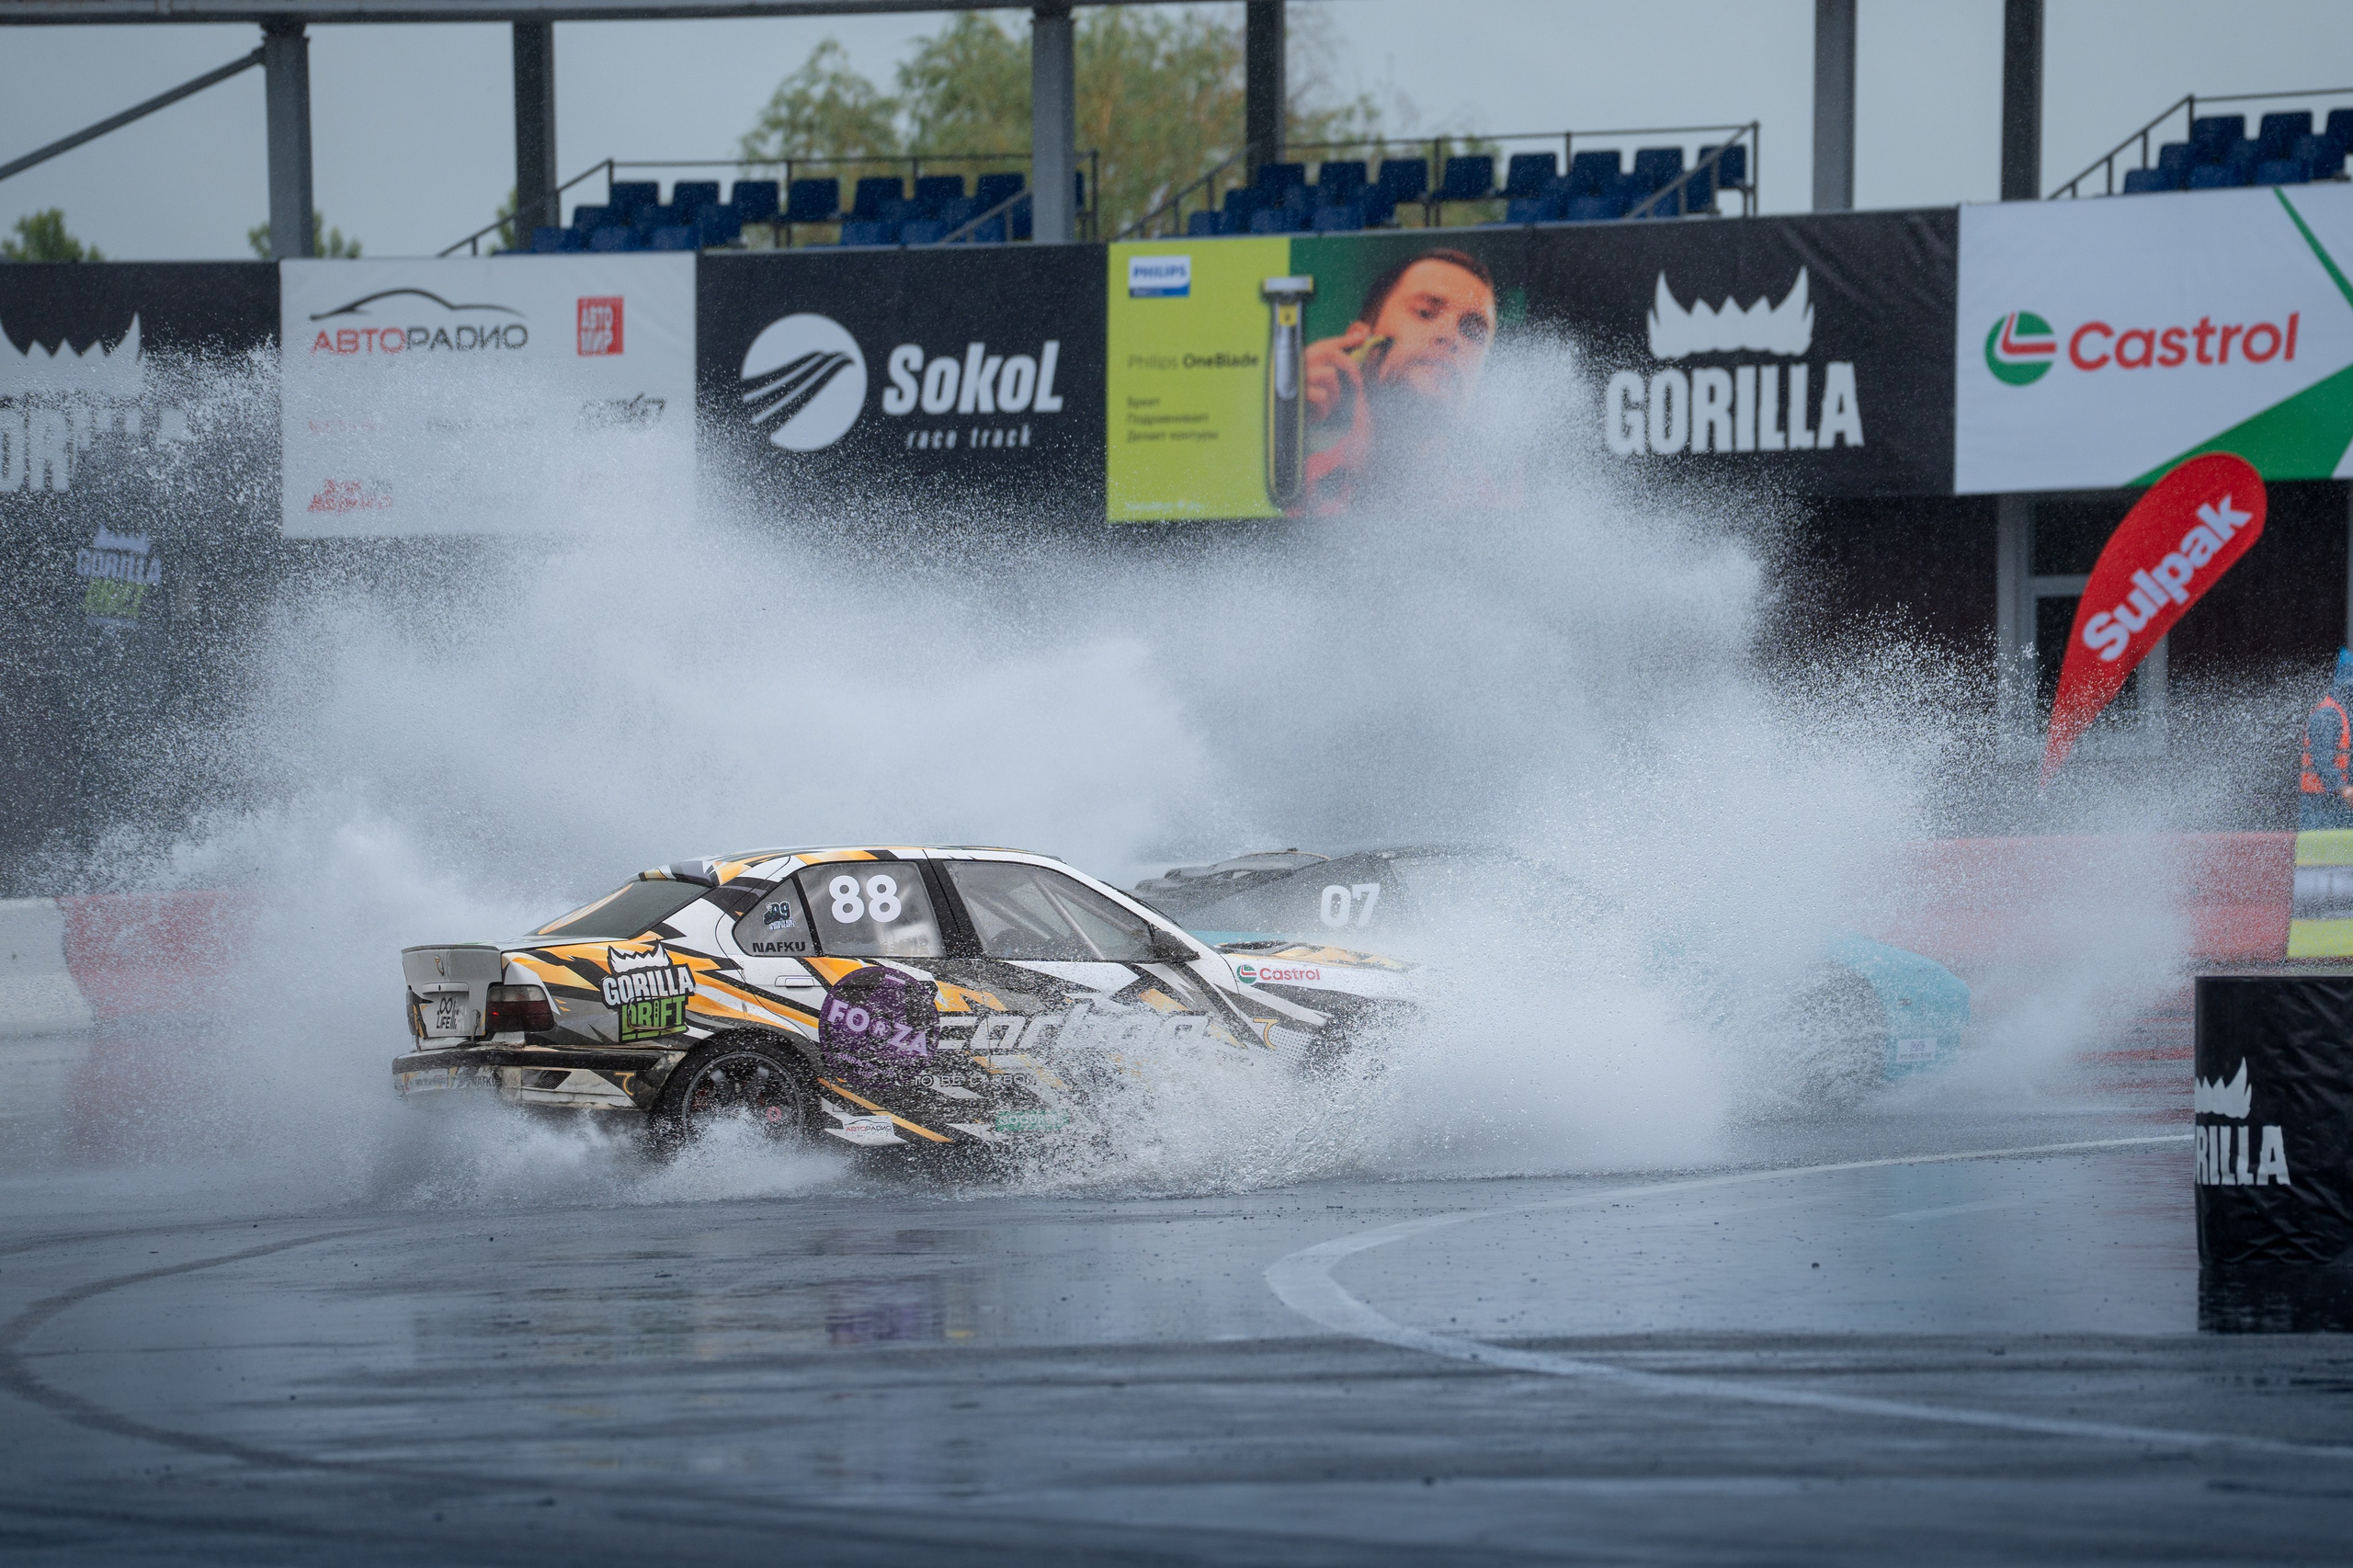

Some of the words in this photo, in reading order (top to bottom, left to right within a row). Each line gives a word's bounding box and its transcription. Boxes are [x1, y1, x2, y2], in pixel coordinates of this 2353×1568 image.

[1132, 264, 1187, 279] PHILIPS
[581, 306, 614, 329] АВТО
[2068, 311, 2300, 371] Castrol
[1129, 354, 1177, 369] Philips
[1182, 351, 1259, 368] OneBlade
[1608, 360, 1866, 457] GORILLA
[905, 428, 958, 449] race
[970, 422, 1031, 449] track
[76, 551, 162, 585] GORILLA
[2082, 493, 2253, 663] Sulpak
[828, 874, 902, 924] 88
[1320, 882, 1381, 927] 07
[752, 941, 806, 953] NAFKU
[602, 966, 694, 1006] GORILLA
[1259, 967, 1321, 981] Castrol
[621, 995, 687, 1039] DRIFT
[826, 998, 927, 1056] FORZA
[914, 1075, 934, 1086] TO
[939, 1075, 961, 1086] BE
[969, 1074, 1037, 1086] CARBON
